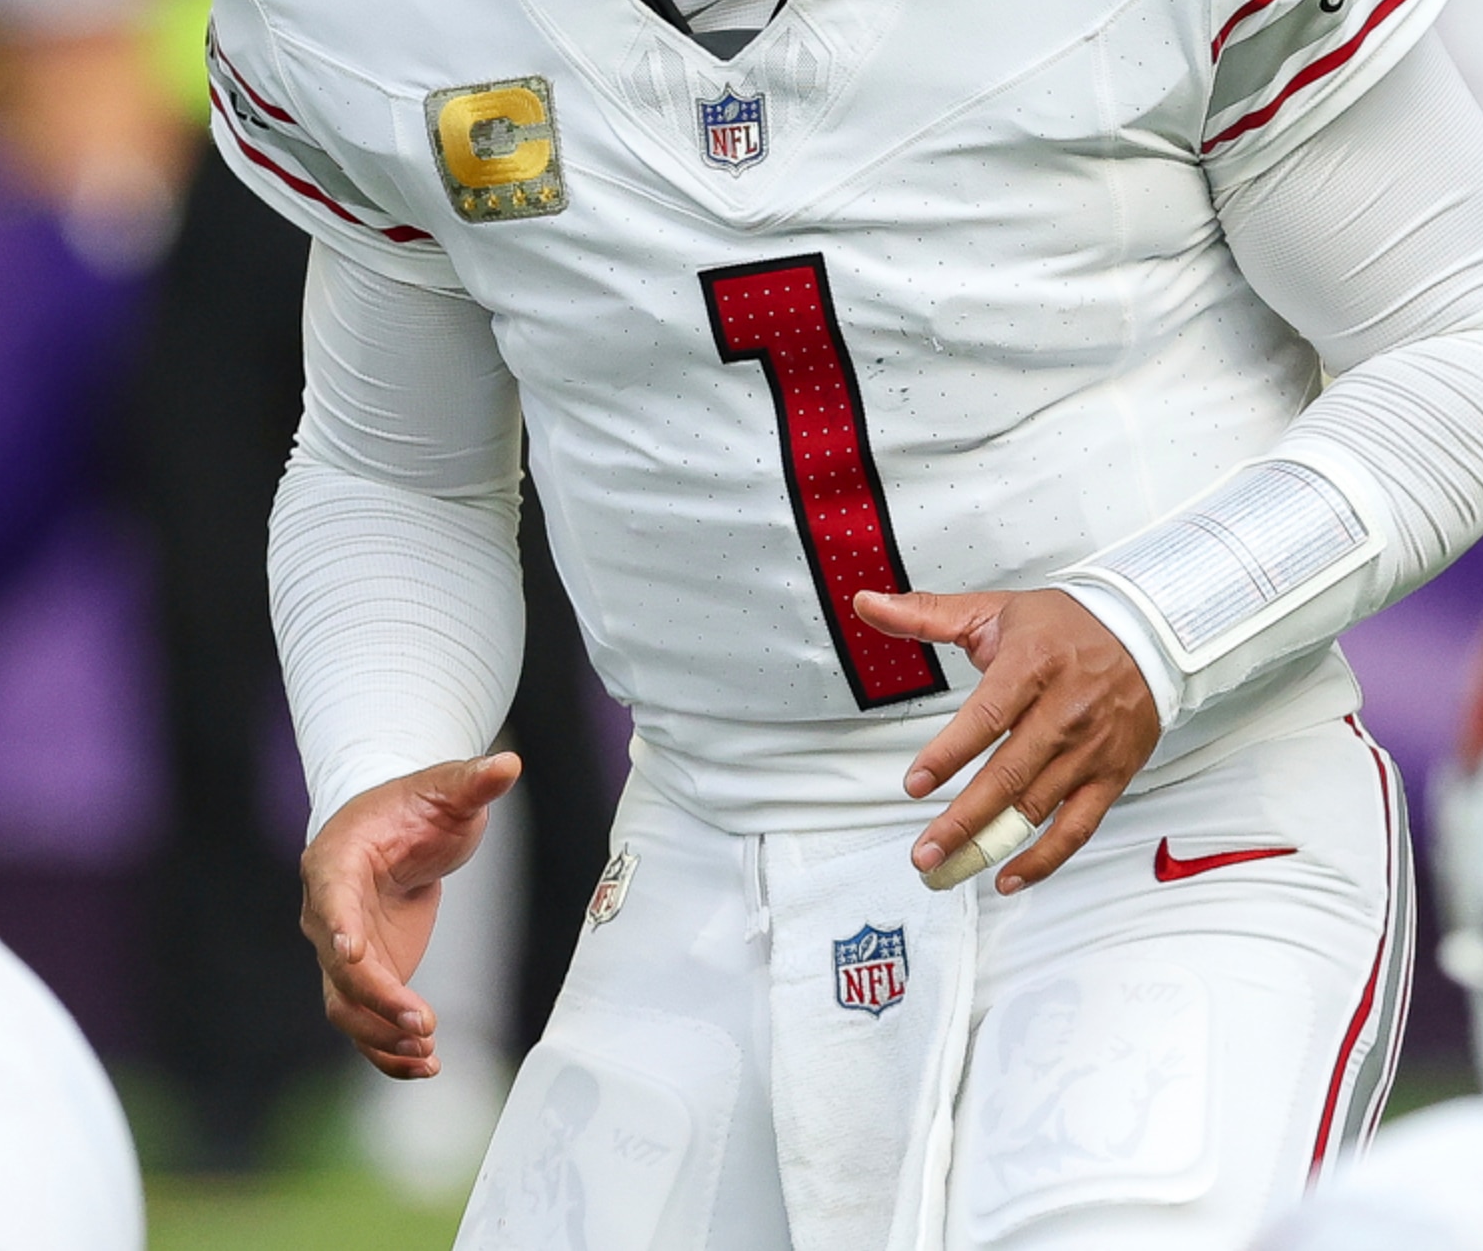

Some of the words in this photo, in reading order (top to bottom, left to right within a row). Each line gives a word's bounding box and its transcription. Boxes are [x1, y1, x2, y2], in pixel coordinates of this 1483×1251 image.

[438, 87, 551, 189] C
[711, 126, 758, 159] NFL
[699, 253, 949, 711] 1
[842, 962, 906, 1007] NFL
